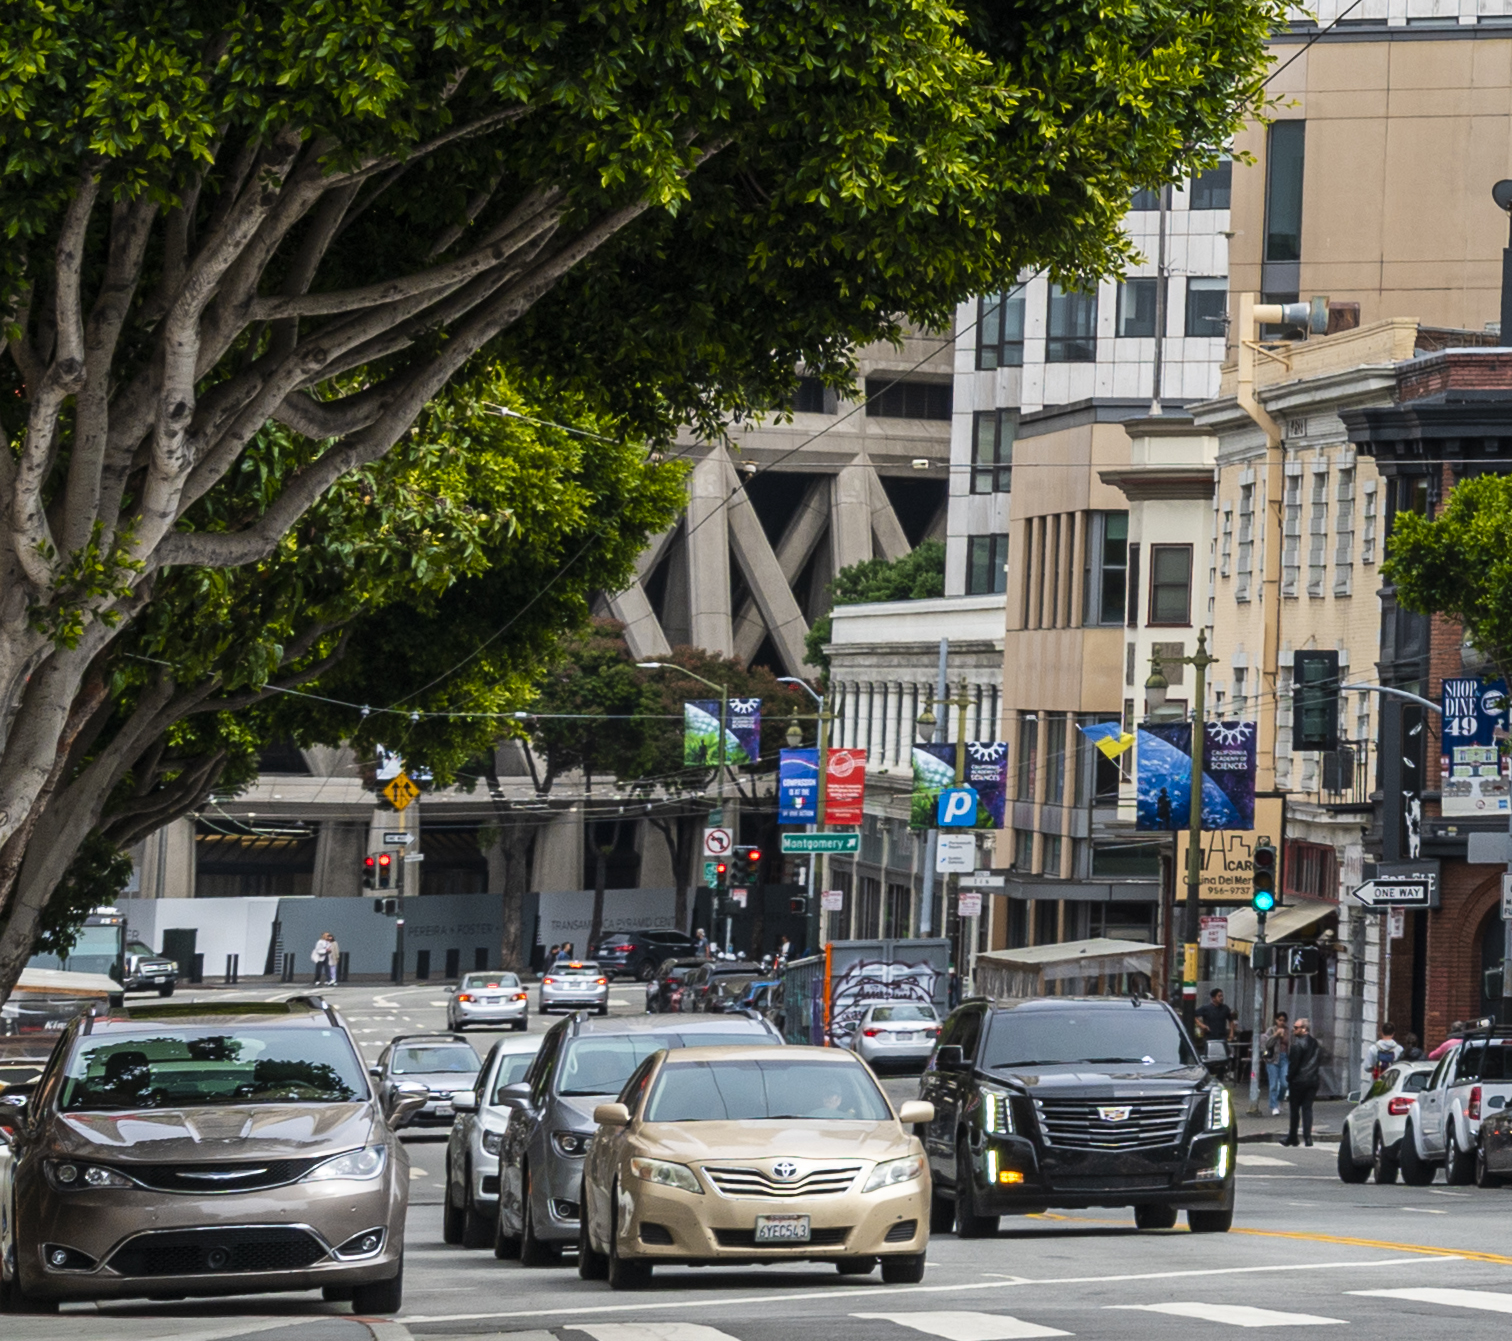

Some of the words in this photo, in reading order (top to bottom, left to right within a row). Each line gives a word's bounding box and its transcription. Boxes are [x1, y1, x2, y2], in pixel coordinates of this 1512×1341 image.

[1445, 680, 1478, 698] SHOP
[1445, 698, 1478, 717] DINE
[1444, 717, 1478, 736] 49
[1211, 762, 1248, 770] SCIENCES
[783, 838, 844, 850] Montgomery
[1218, 875, 1234, 885] Del
[1207, 886, 1251, 895] 956-9737
[1374, 888, 1396, 898] ONE
[1399, 888, 1421, 897] WAY
[760, 1224, 807, 1237] 6YEC543
